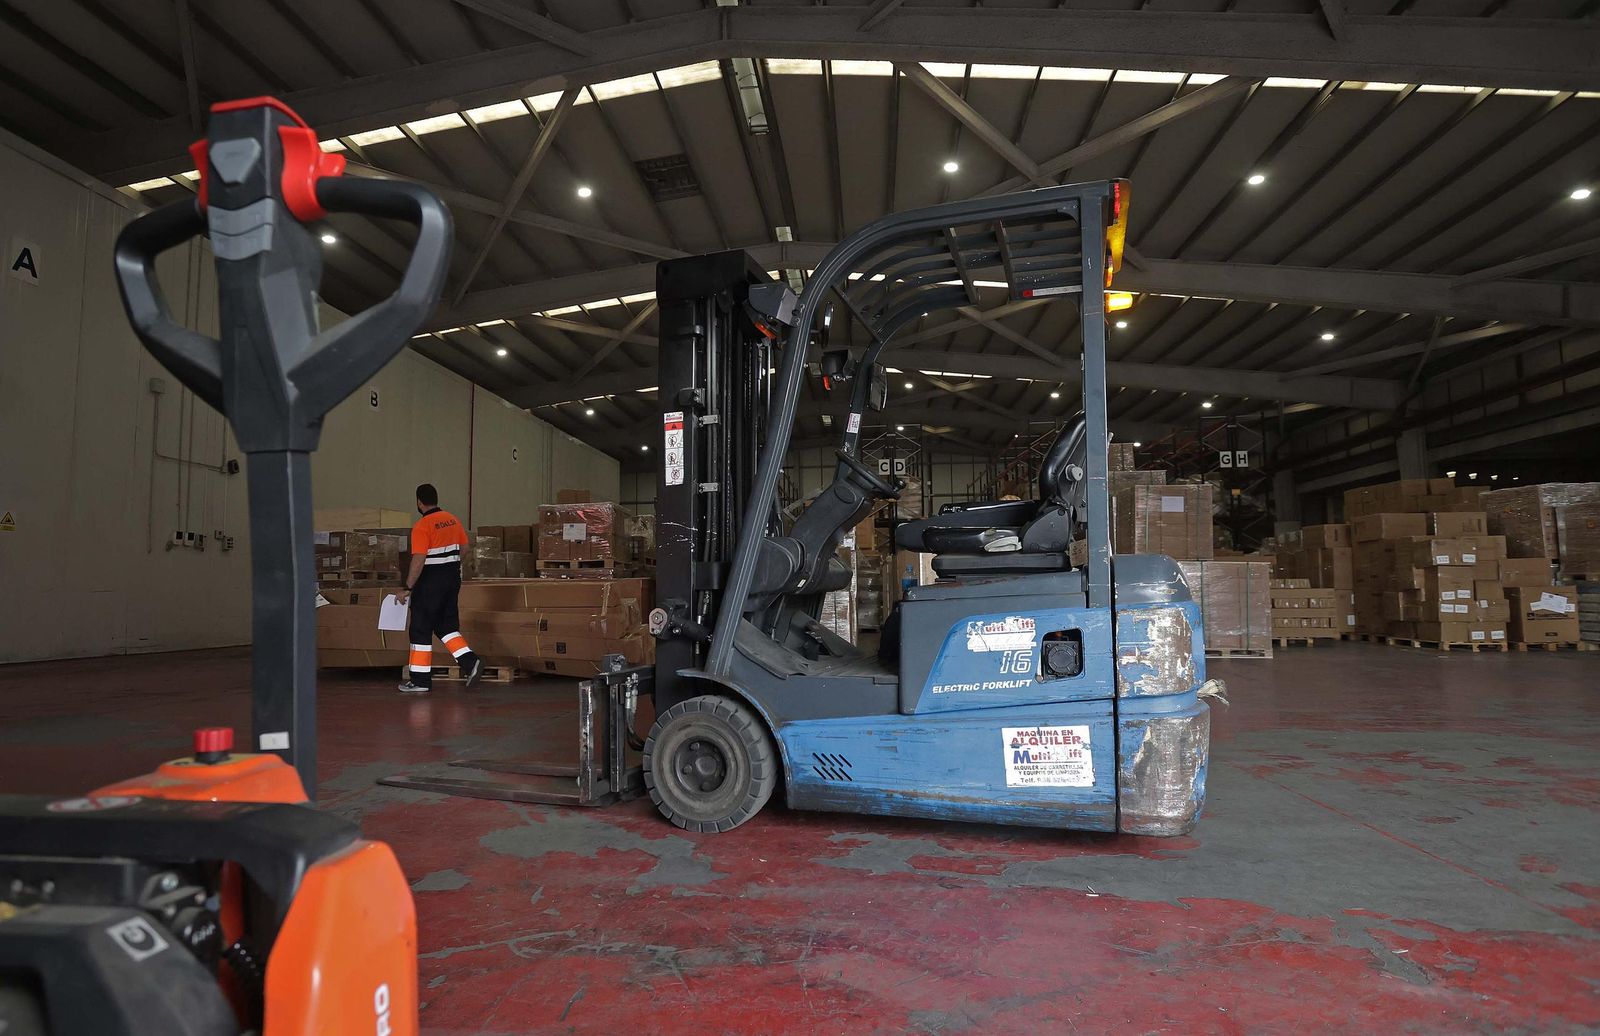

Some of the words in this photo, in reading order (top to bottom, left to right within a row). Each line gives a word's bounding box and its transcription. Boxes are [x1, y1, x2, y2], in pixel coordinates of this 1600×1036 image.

[12, 247, 37, 278] A
[371, 391, 378, 407] B
[512, 449, 517, 460] C
[1221, 454, 1231, 464] G
[1238, 454, 1246, 464] H
[880, 462, 888, 472] C
[896, 462, 904, 471] D
[1000, 651, 1033, 674] 16
[933, 683, 980, 694] ELECTRIC
[982, 680, 1033, 690] FORKLIFT
[1011, 735, 1081, 746] ALQUILER
